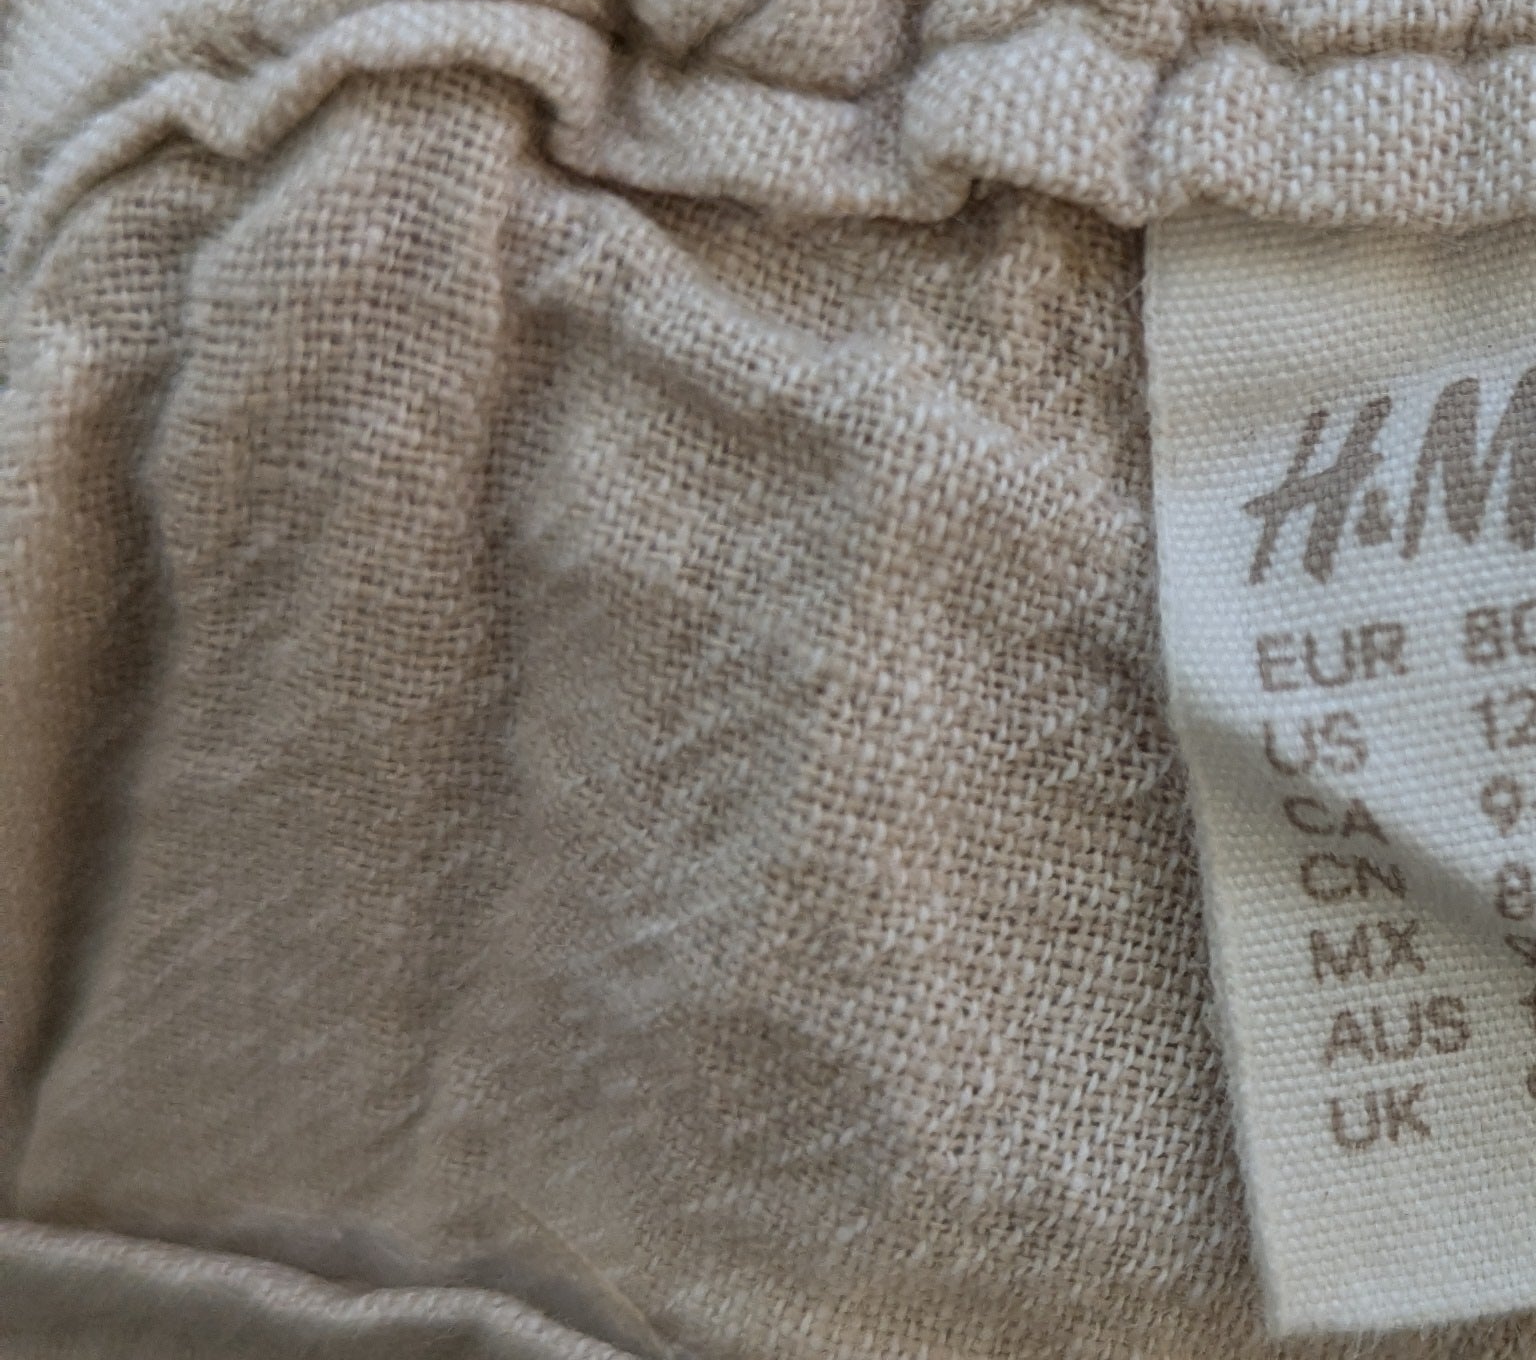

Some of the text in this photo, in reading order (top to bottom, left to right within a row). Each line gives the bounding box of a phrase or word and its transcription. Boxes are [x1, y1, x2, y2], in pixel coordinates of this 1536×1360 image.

[1256, 622, 1410, 692] EUR
[1262, 709, 1370, 777] US
[1282, 796, 1390, 846] CA
[1300, 851, 1408, 903] CN
[1310, 918, 1428, 986] MX
[1324, 994, 1471, 1068] AUS
[1328, 1083, 1434, 1152] UK
